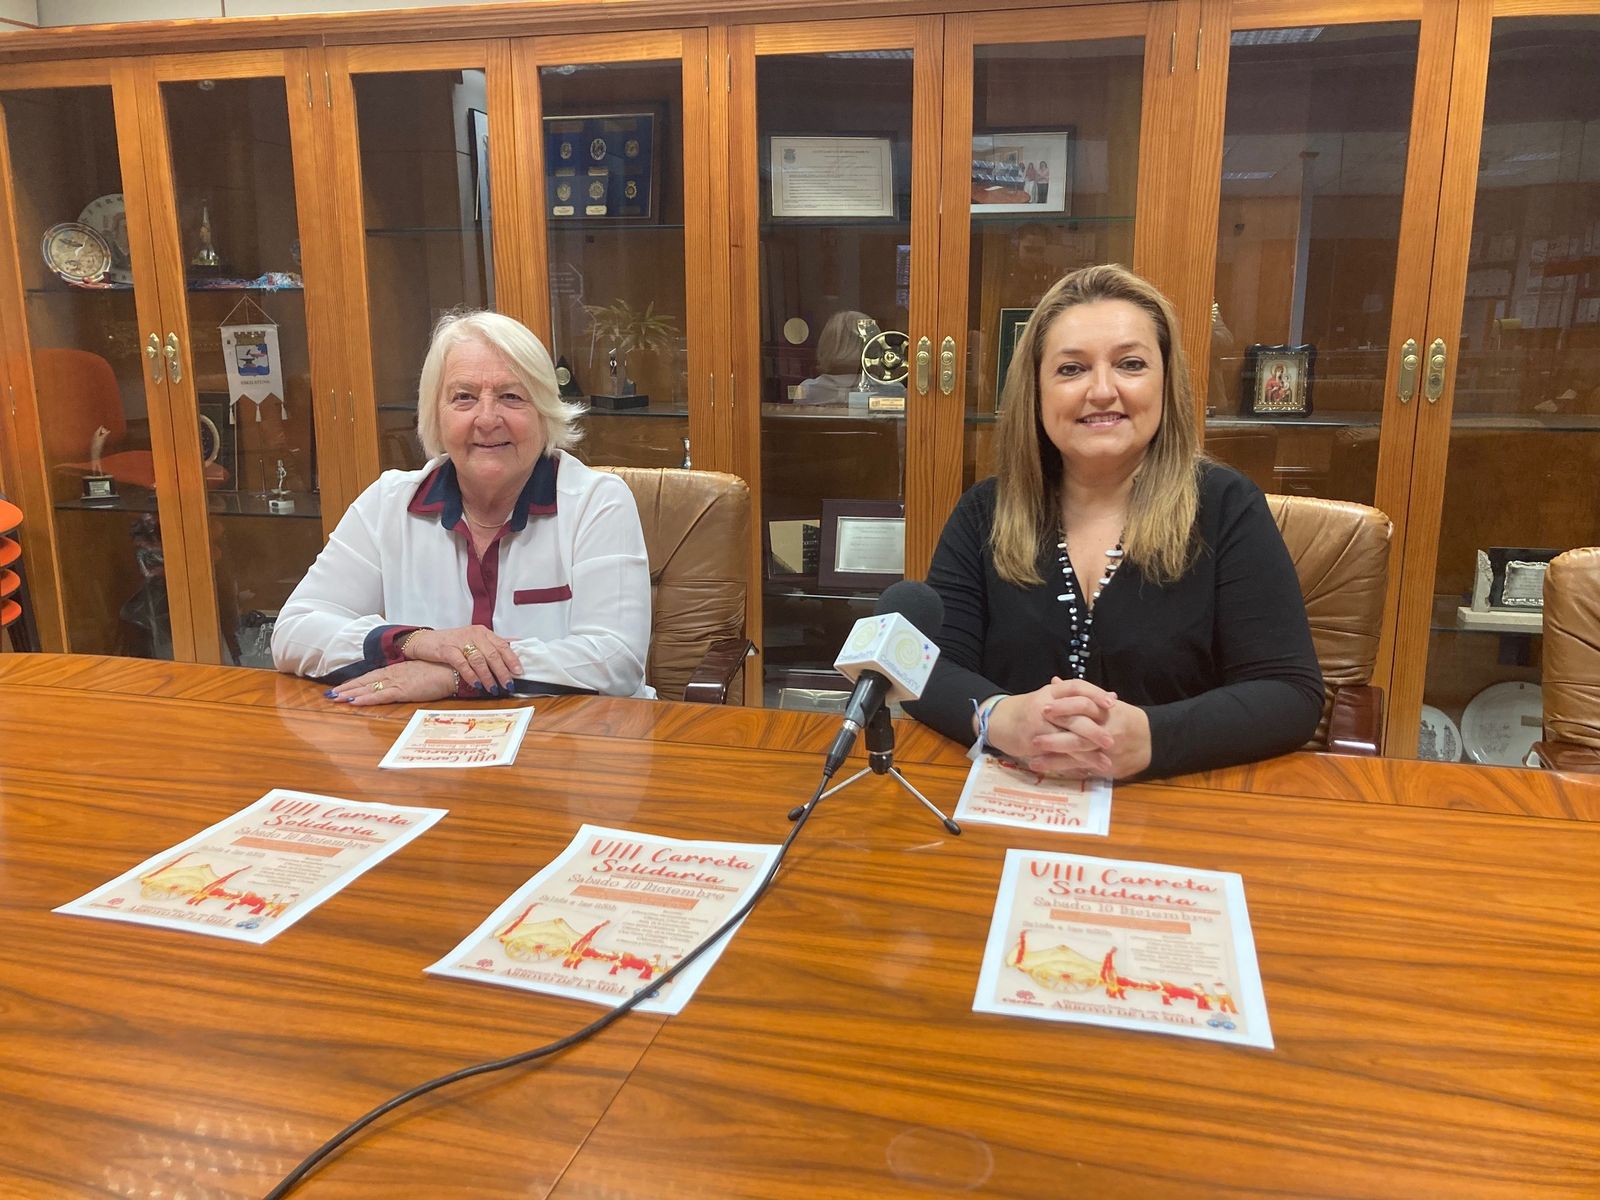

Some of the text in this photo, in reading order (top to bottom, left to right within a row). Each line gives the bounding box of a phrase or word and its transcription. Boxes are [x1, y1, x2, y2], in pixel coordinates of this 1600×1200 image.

[263, 814, 378, 836] Solidaria
[269, 798, 414, 826] VIII Carreta
[969, 806, 1038, 823] Carreta
[590, 838, 755, 870] VIII Carreta
[592, 858, 726, 884] Solidaria
[1030, 860, 1218, 893] VIII Carreta
[1048, 879, 1199, 907] Solidaria
